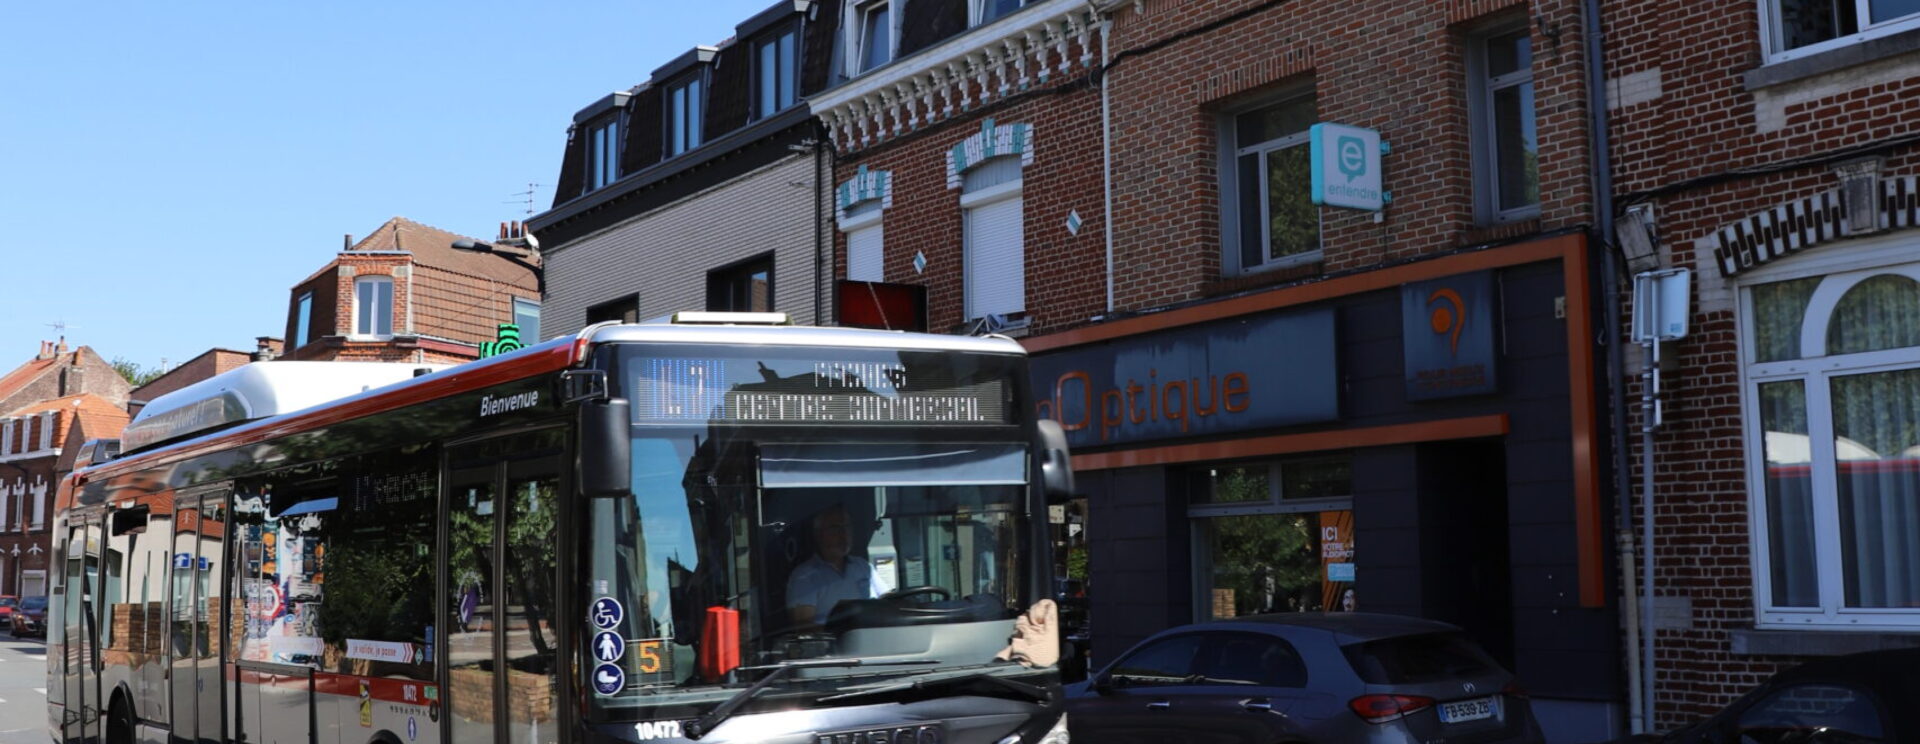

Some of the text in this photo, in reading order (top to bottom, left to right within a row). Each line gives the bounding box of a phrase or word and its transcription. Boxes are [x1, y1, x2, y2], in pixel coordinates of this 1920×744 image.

[1328, 184, 1378, 200] entendre
[480, 390, 539, 417] Bienvenue
[1321, 526, 1339, 541] ICI
[639, 641, 661, 673] 5
[634, 720, 682, 740] 10472
